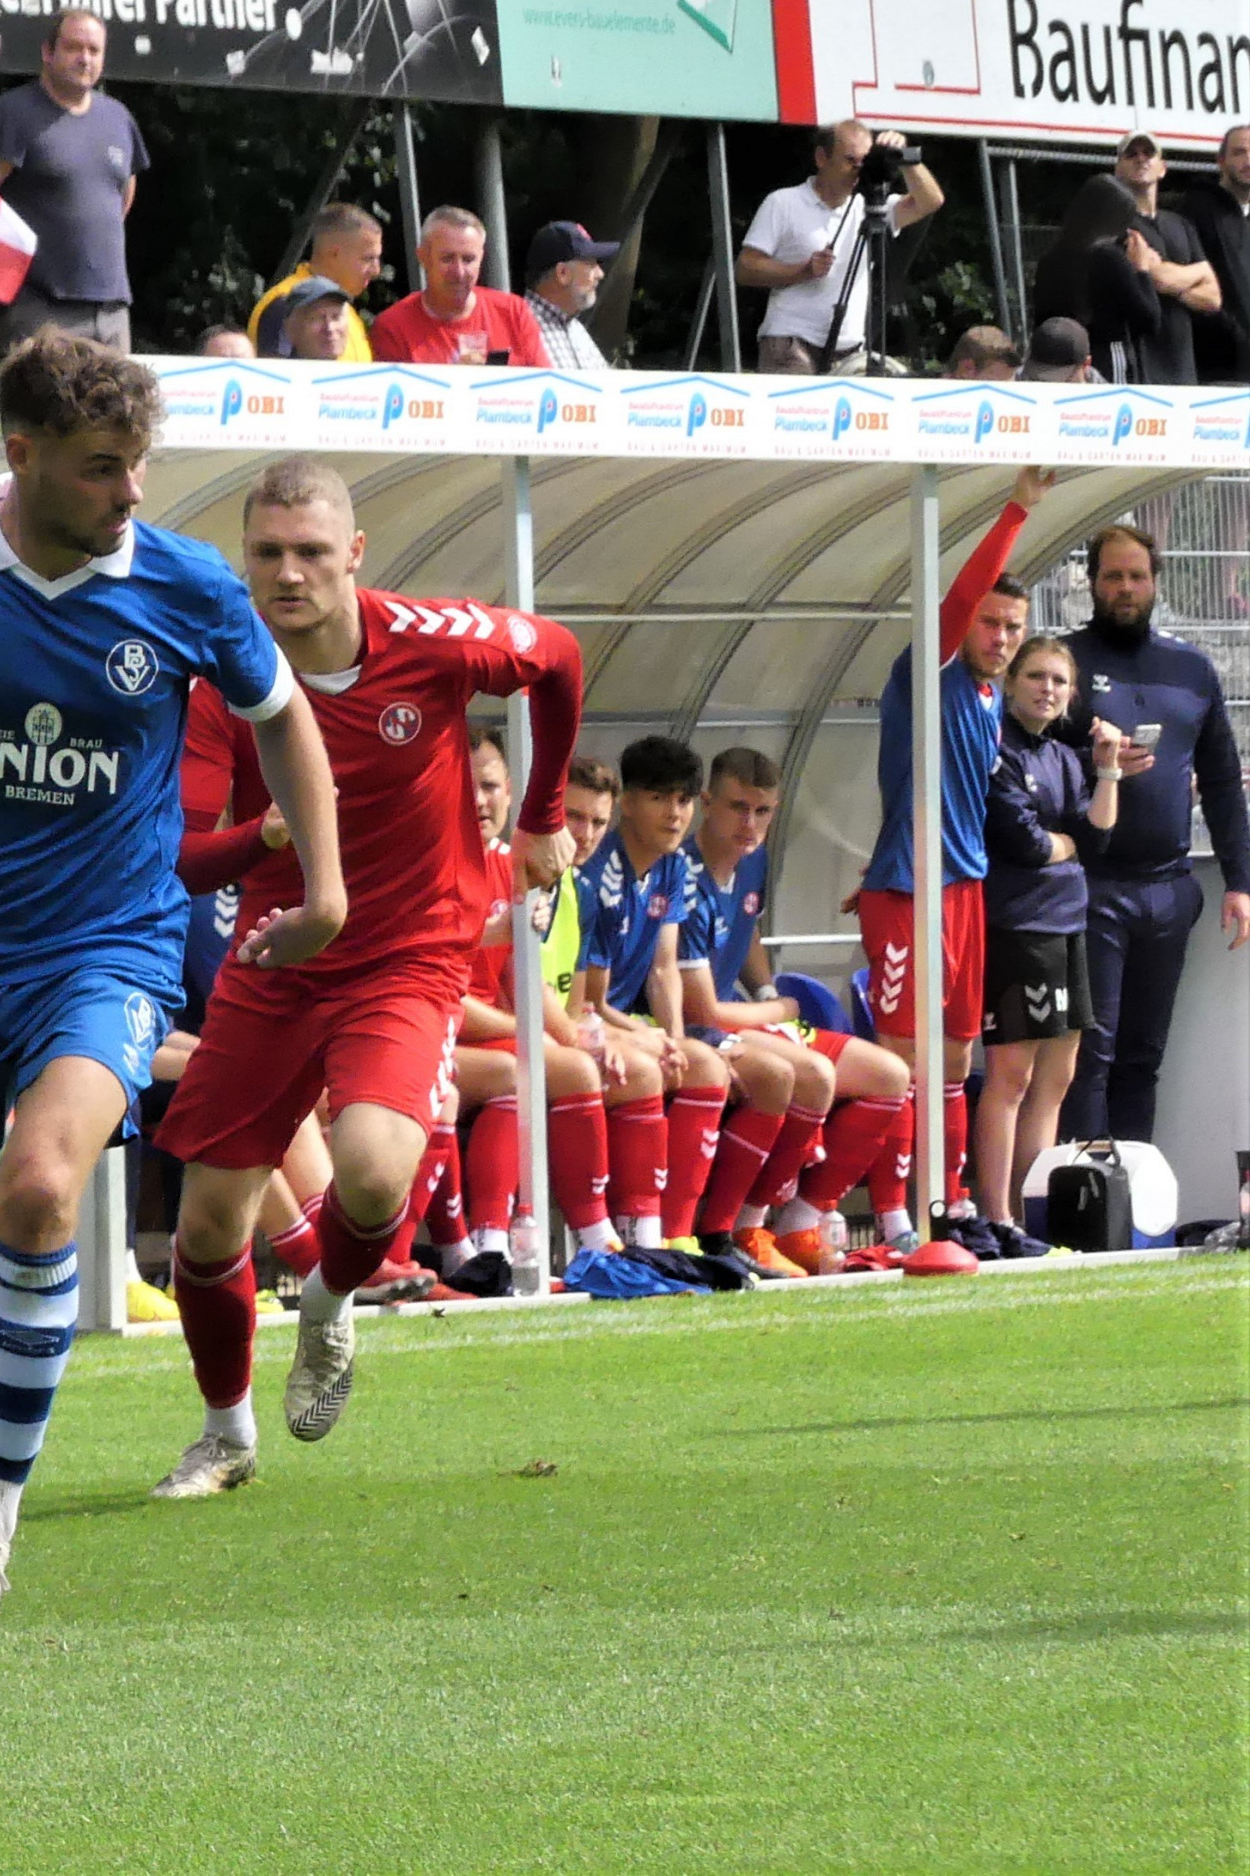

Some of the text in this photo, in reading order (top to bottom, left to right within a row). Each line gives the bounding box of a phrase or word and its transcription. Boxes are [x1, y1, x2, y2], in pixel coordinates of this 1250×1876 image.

[247, 395, 284, 415] OBI
[408, 399, 444, 419] OBI
[561, 404, 596, 423] OBI
[710, 408, 745, 427] OBI
[855, 412, 889, 431] OBI
[997, 415, 1030, 434] OBI
[1135, 418, 1167, 437] OBI
[69, 737, 103, 750] BRAU
[5, 784, 75, 806] BREMEN
